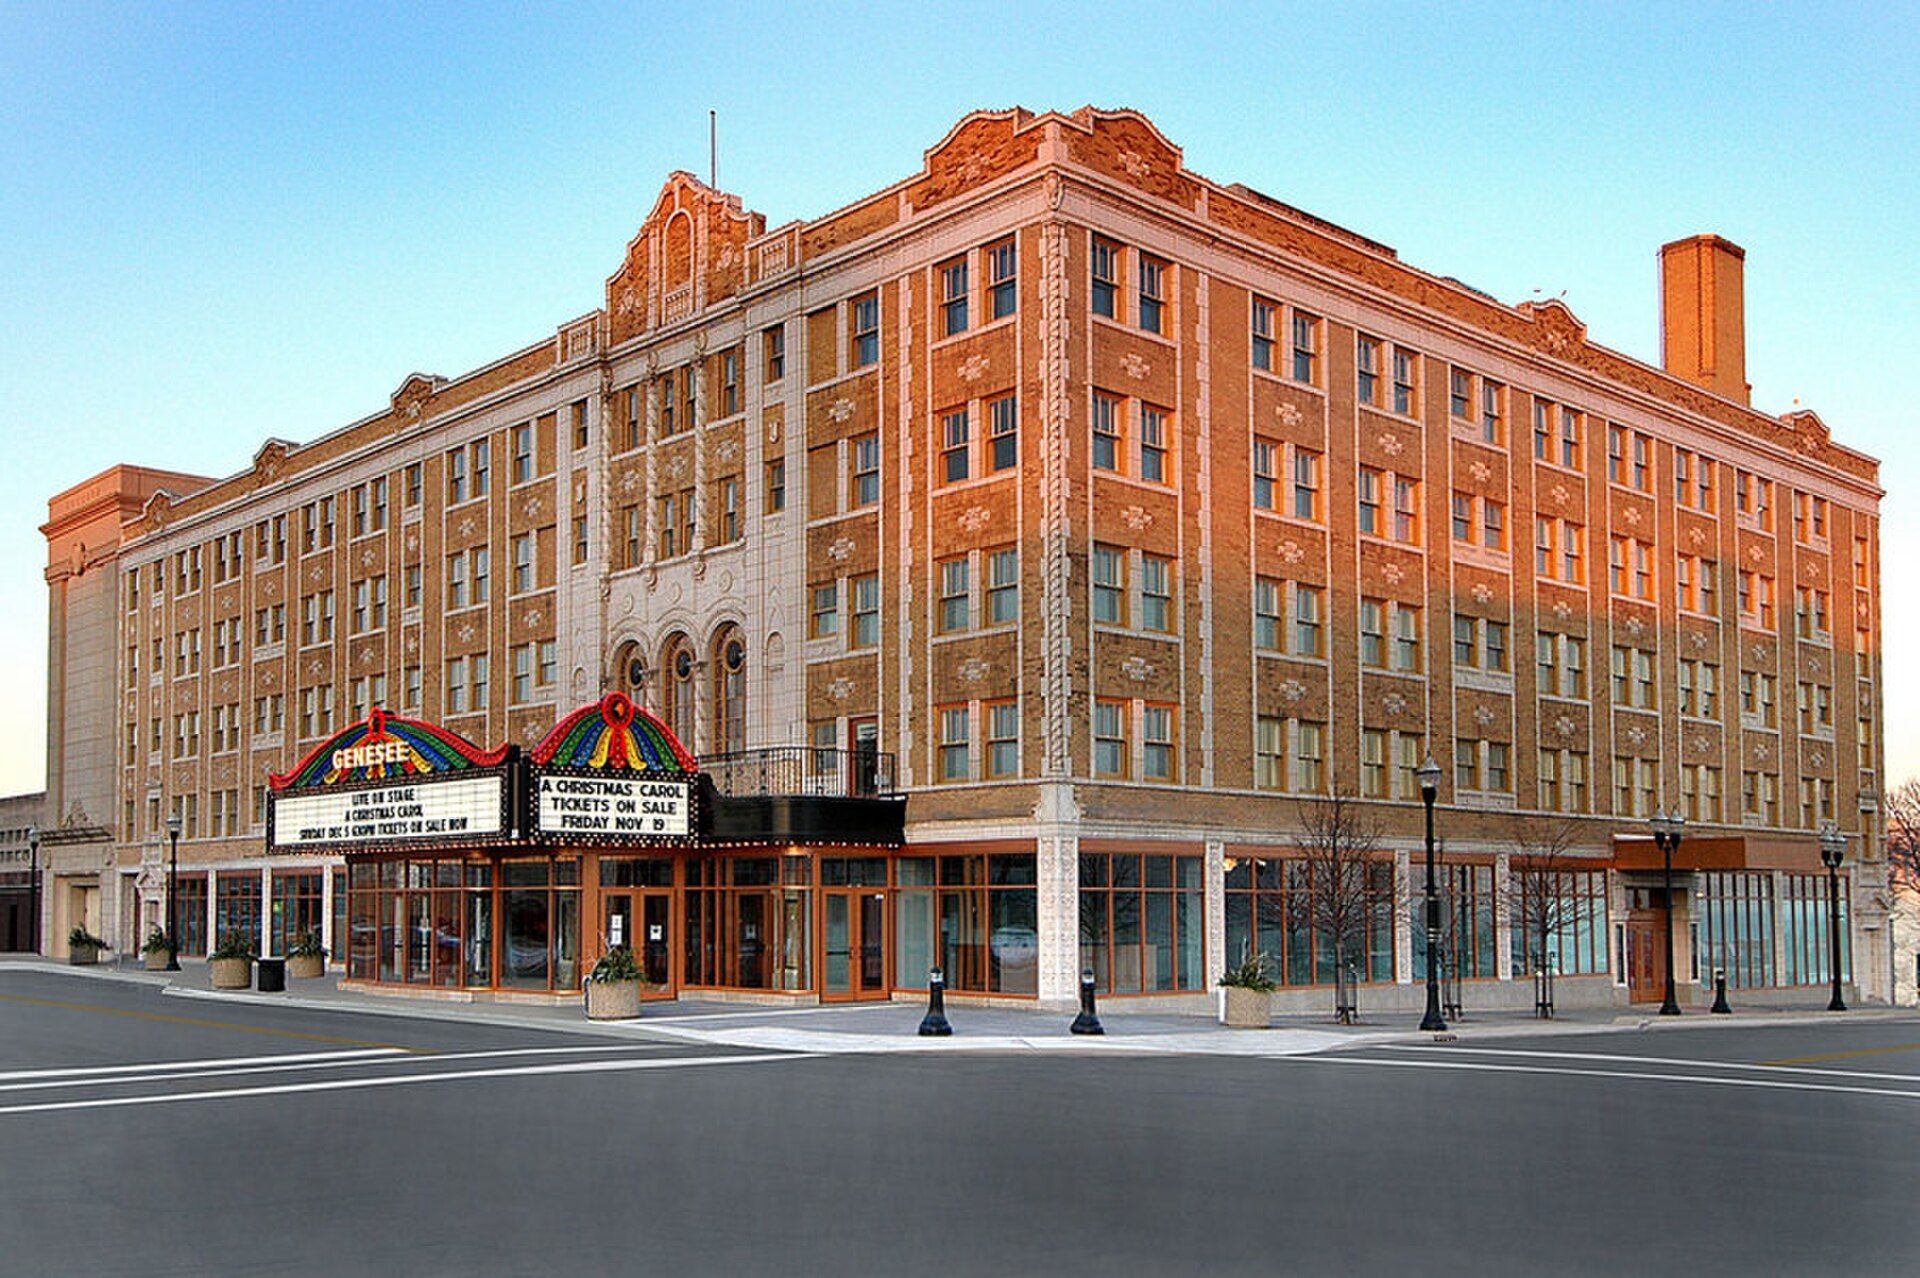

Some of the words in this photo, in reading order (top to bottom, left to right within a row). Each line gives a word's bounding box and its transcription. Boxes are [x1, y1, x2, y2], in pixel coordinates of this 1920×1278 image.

[332, 741, 410, 769] GENESEE
[388, 788, 415, 803] STAGE
[541, 779, 552, 793] A
[556, 780, 633, 796] CHRISTMAS
[639, 785, 683, 799] CAROL
[352, 806, 395, 821] CHRISTMAS
[397, 804, 423, 818] CAROL
[551, 797, 610, 812] TICKETS
[616, 800, 636, 813] ON
[642, 801, 677, 815] SALE
[378, 821, 408, 835] TICKETS
[426, 819, 447, 832] SALE
[561, 815, 609, 829] FRIDAY
[615, 817, 643, 830] NOV
